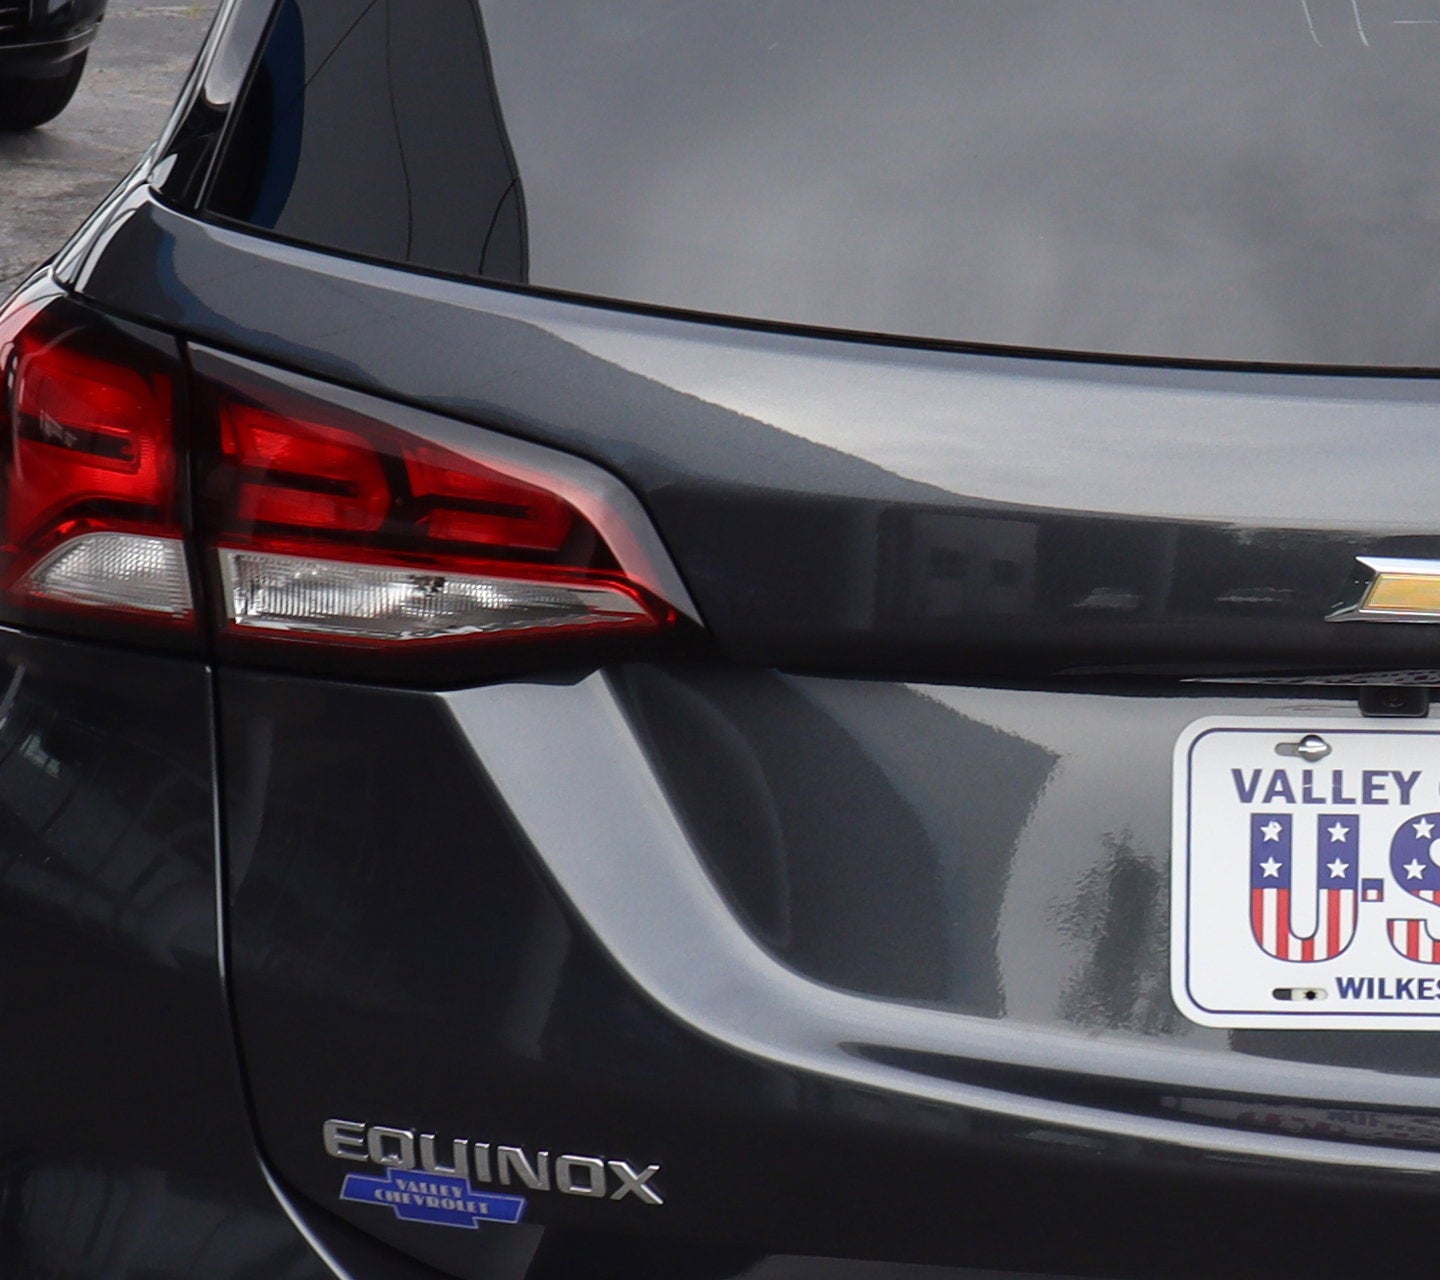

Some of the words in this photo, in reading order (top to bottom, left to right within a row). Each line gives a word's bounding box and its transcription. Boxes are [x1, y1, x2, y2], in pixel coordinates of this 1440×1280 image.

[1230, 768, 1422, 806] VALLEY
[322, 1119, 664, 1205] EQUINOX
[373, 1188, 490, 1215] CHEVROLET
[394, 1178, 464, 1199] VALLEY
